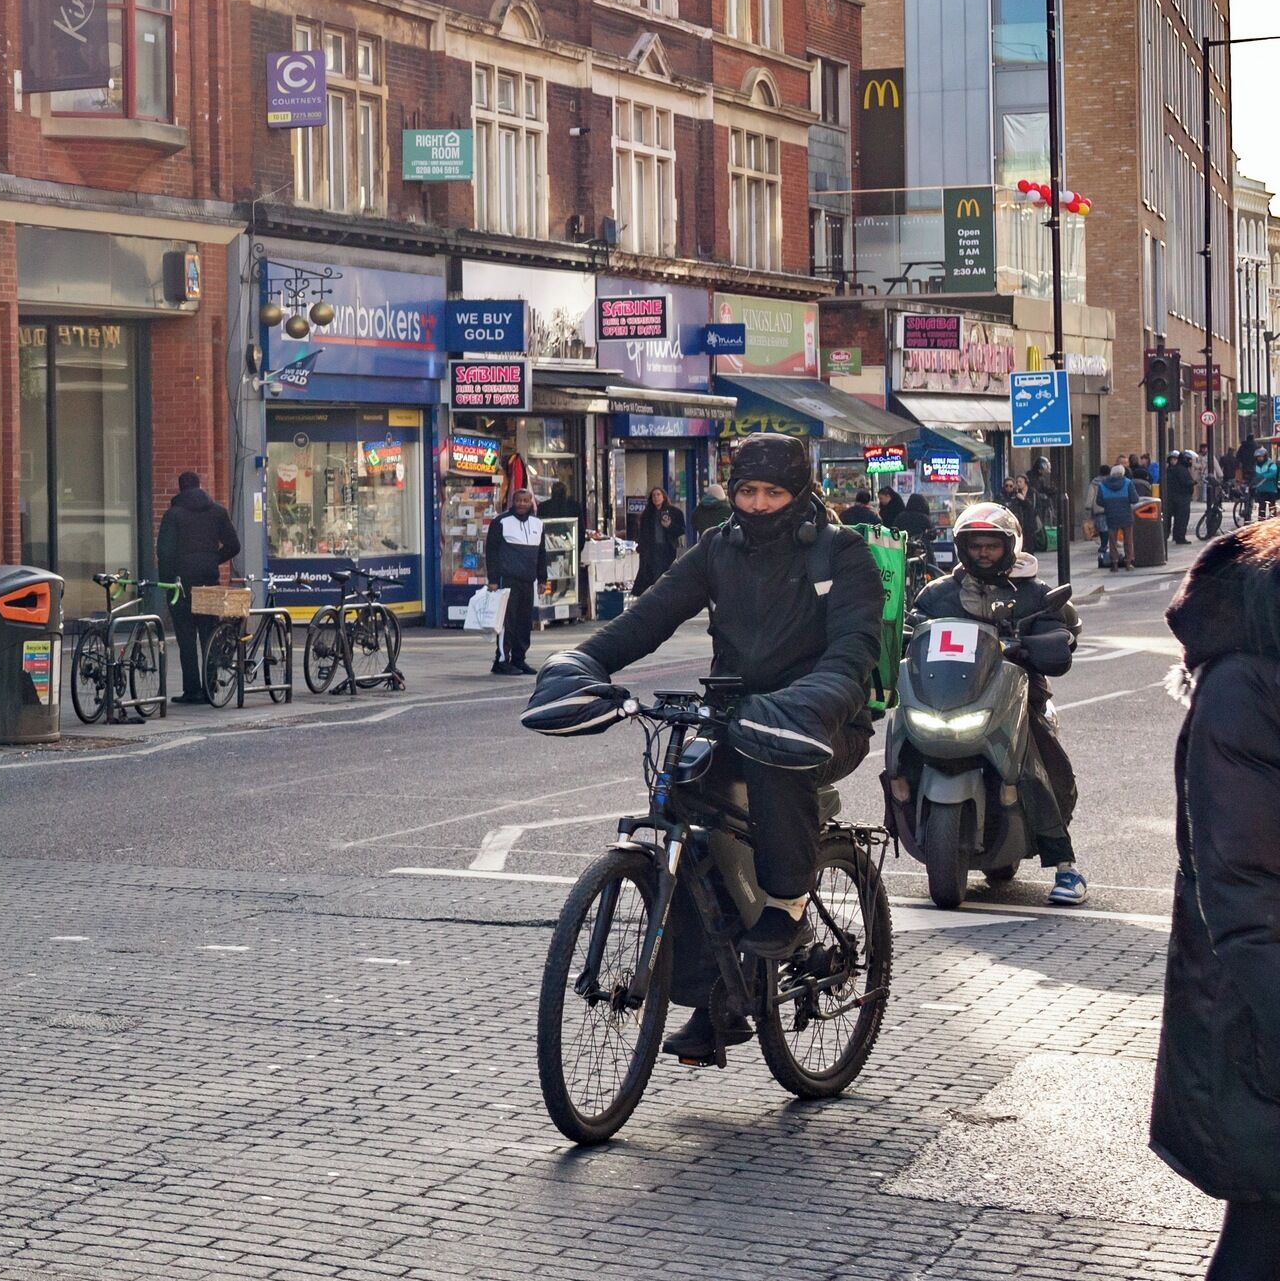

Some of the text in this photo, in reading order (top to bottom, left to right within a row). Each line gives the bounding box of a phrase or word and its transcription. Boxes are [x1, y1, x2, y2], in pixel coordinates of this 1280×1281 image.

[272, 97, 322, 106] COURTNEYS
[416, 134, 443, 147] RIGHT
[432, 147, 460, 160] ROOM
[957, 229, 980, 238] Open
[959, 238, 980, 246] from
[966, 248, 980, 256] AM
[965, 257, 974, 265] to
[953, 267, 986, 276] 2:30 AM
[602, 299, 663, 317] SABINE
[456, 312, 513, 325] WE BUY
[742, 308, 793, 333] KINGSLAND
[464, 328, 505, 341] GOLD
[602, 324, 662, 336] OPEN 7 DAYS
[717, 335, 744, 344] mind
[280, 374, 308, 385] GOLD
[455, 366, 521, 384] SABINE
[456, 394, 520, 405] OPEN 7 DAYS
[453, 452, 479, 463] REPAIRS
[300, 572, 332, 583] Money
[940, 631, 964, 653] L
